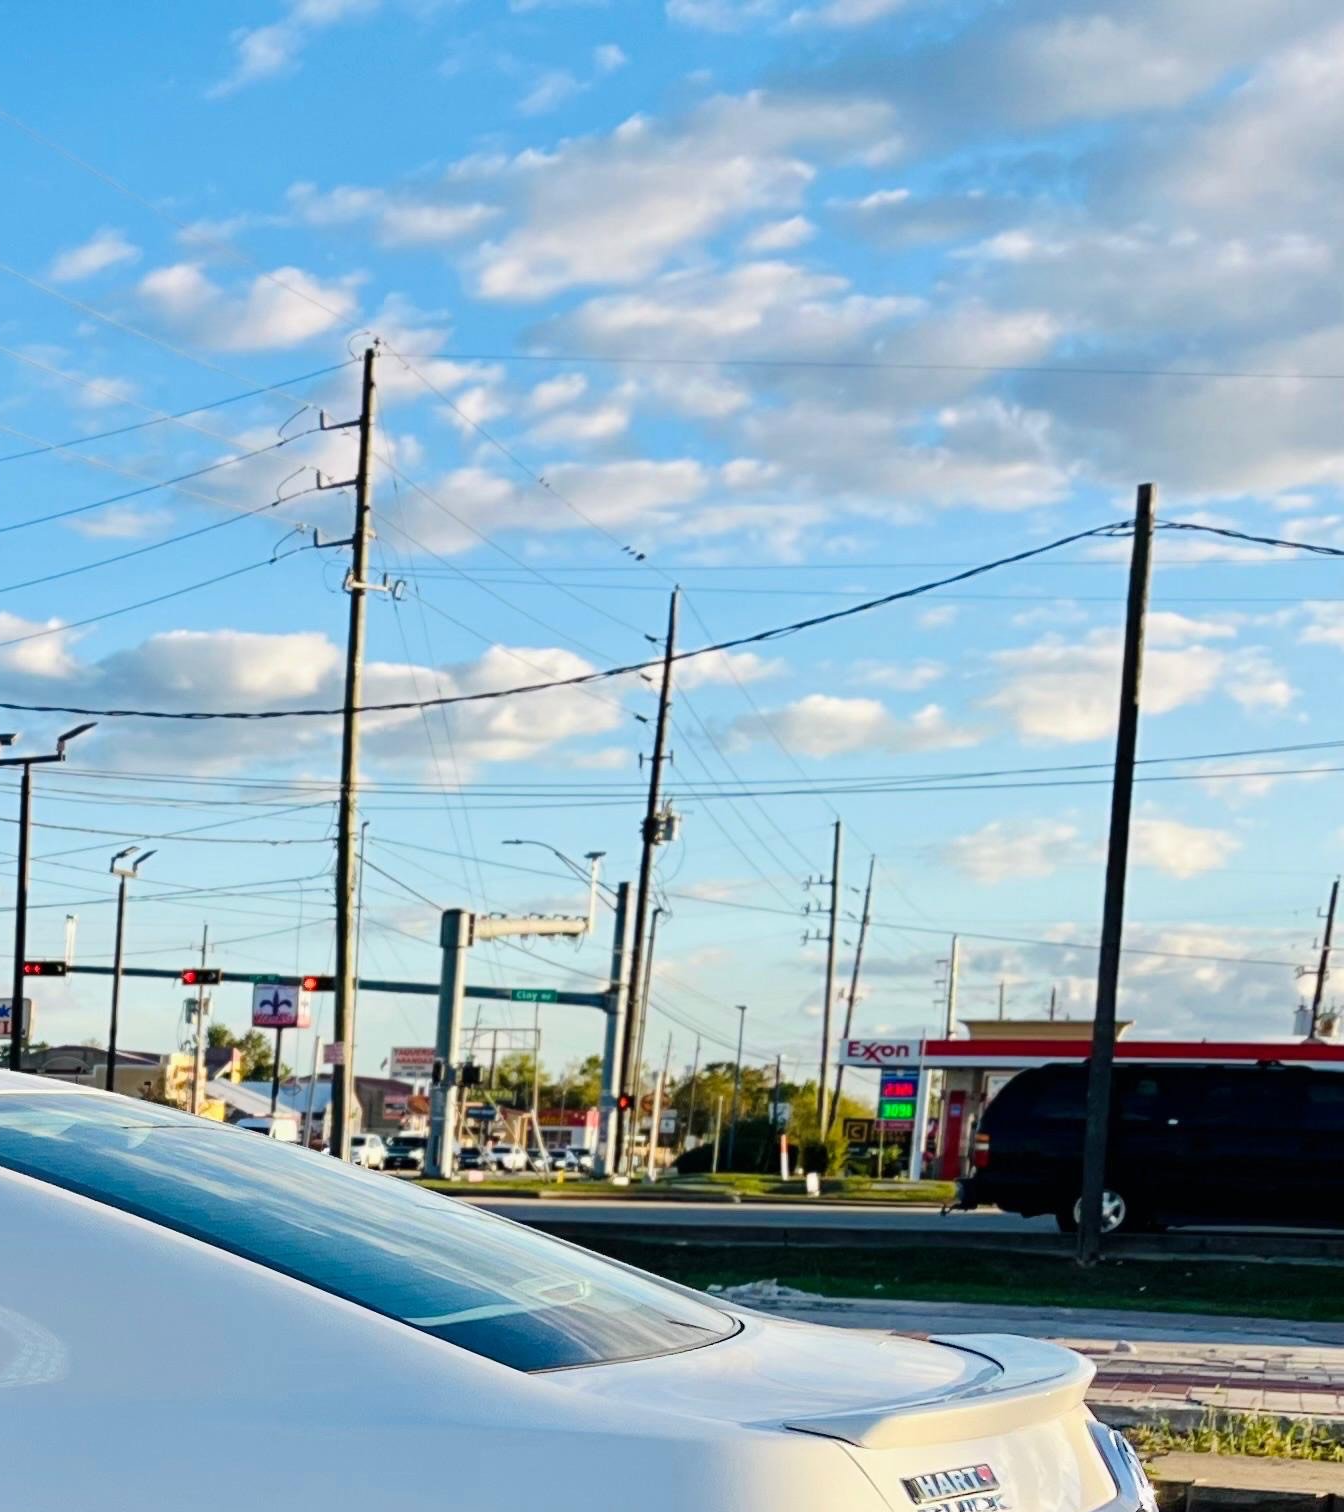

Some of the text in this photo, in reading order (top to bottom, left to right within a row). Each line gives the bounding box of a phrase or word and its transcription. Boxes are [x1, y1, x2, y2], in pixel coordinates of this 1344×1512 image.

[516, 990, 538, 1001] Clay
[847, 1040, 909, 1063] Exxon
[914, 1467, 981, 1498] HART
